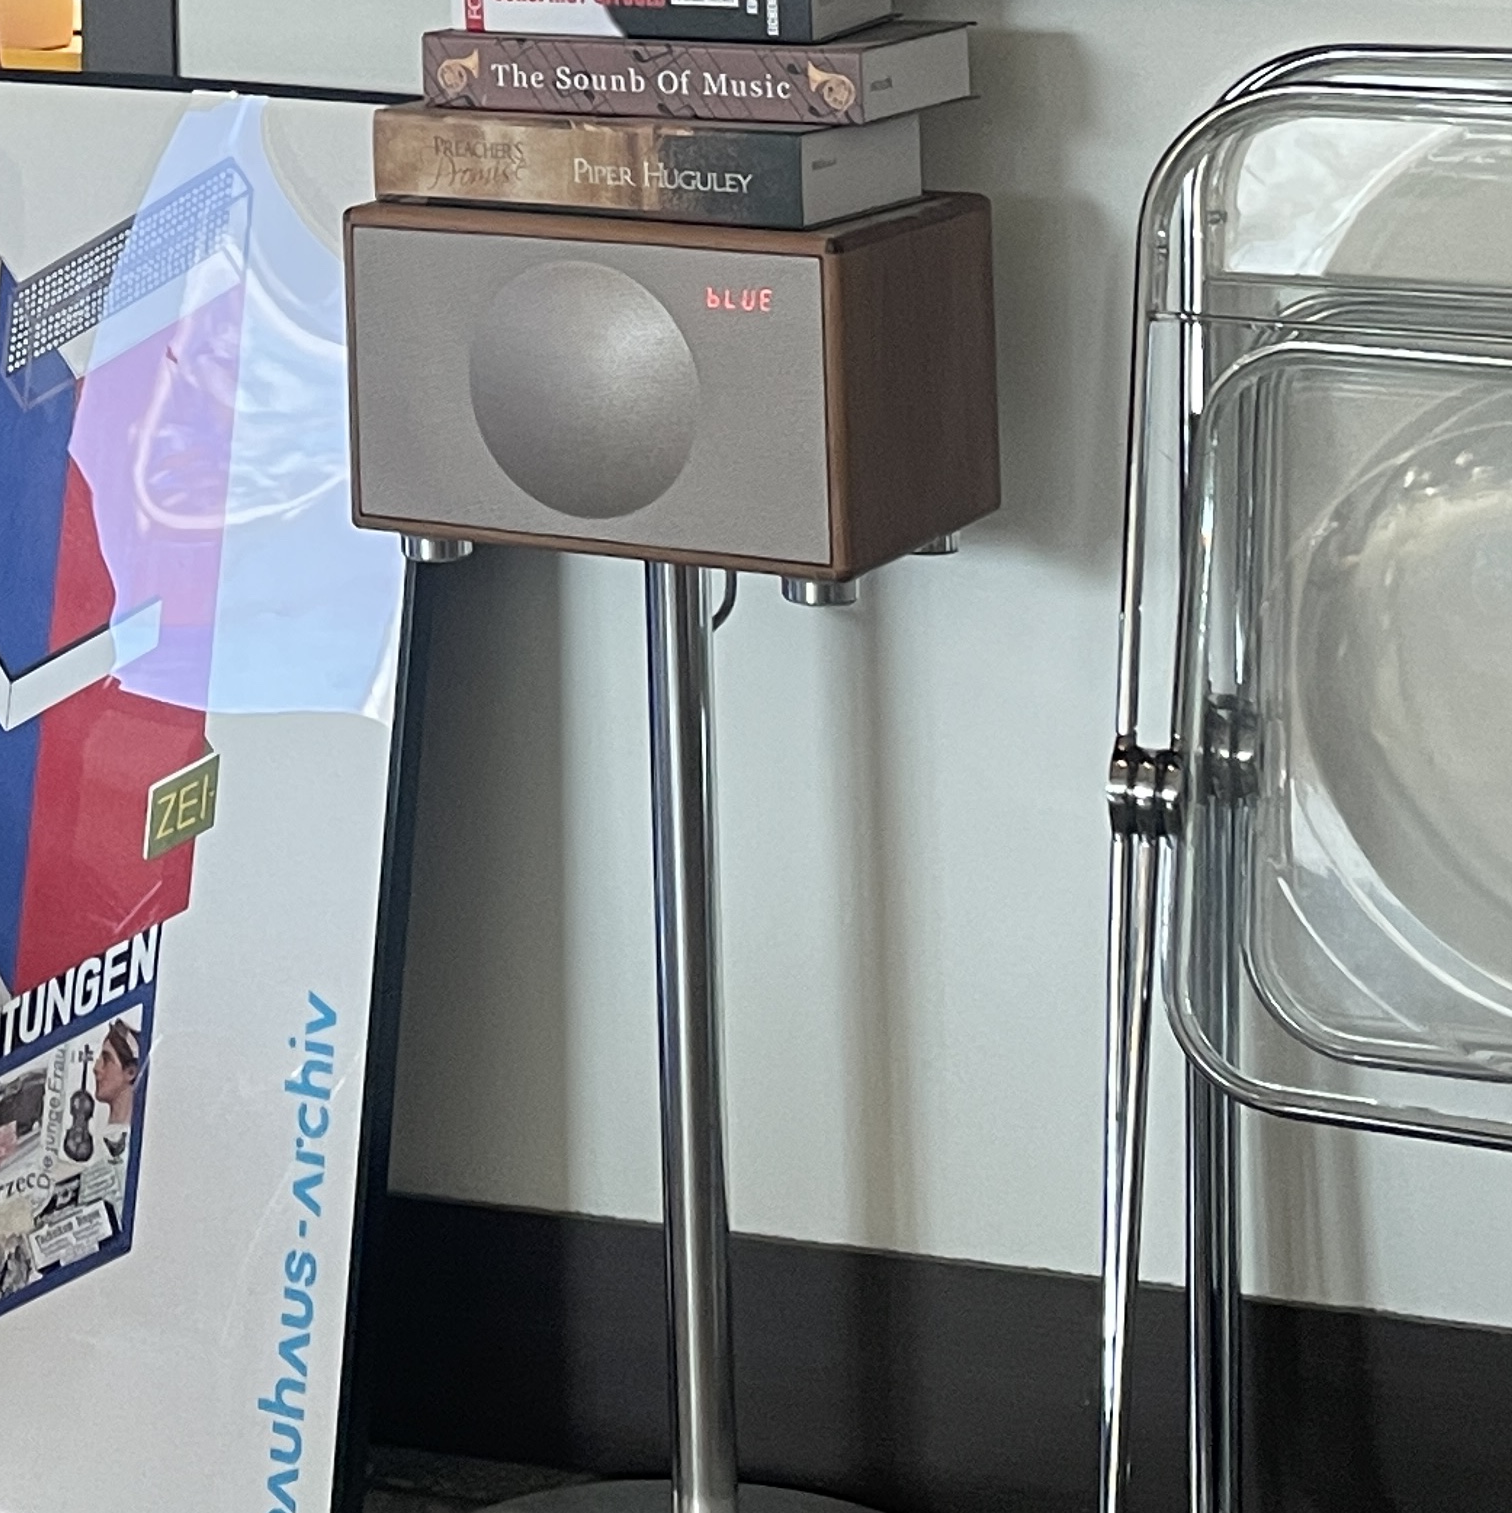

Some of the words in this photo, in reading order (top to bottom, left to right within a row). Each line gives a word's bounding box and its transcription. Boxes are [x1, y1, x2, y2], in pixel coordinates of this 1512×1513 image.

[490, 63, 544, 88] The
[555, 66, 645, 93] Sounb
[657, 70, 691, 95] Of
[702, 72, 791, 99] Music
[573, 158, 636, 187] PIPER
[643, 161, 753, 194] HUGULEY
[154, 773, 215, 840] ZEI
